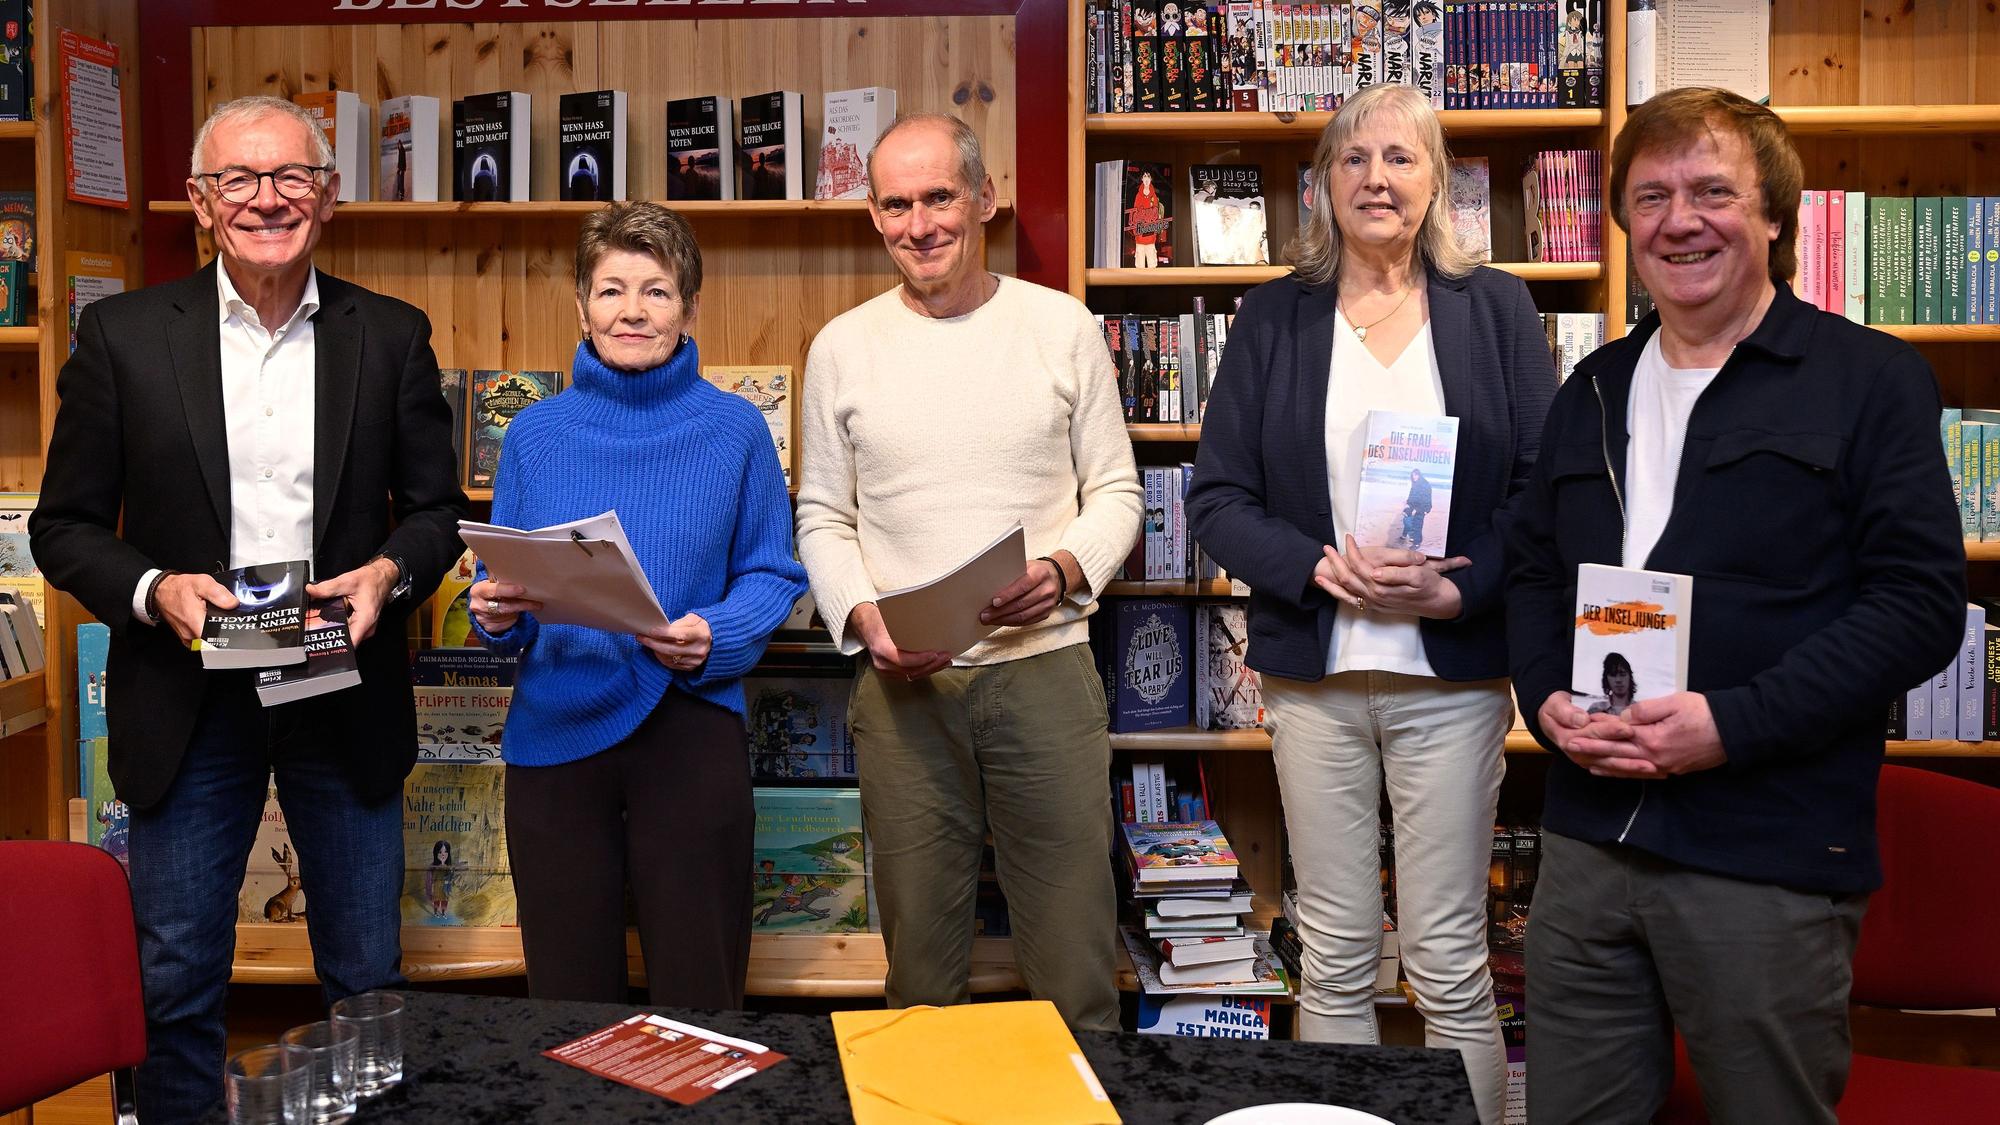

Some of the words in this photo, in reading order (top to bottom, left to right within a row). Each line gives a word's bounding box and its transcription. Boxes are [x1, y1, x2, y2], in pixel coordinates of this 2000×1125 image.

[1417, 52, 1433, 103] NARUT
[1433, 89, 1441, 98] 22
[1568, 89, 1573, 98] 1
[1591, 87, 1598, 97] 2
[466, 123, 486, 133] WENN
[486, 122, 503, 131] HASS
[563, 123, 583, 132] WENN
[585, 121, 604, 130] HASS
[670, 128, 691, 137] WENN
[691, 126, 716, 136] BLICKE
[744, 124, 761, 134] WENN
[762, 121, 782, 131] BLICKE
[466, 134, 485, 144] BLIND
[485, 132, 508, 142] MACHT
[563, 133, 583, 143] BLIND
[584, 131, 611, 141] MACHT
[670, 138, 692, 147] TÖTEN
[744, 134, 763, 145] TÖTEN
[1198, 169, 1260, 182] BUNGO
[1951, 206, 1959, 253] BILLIONAIRES
[1951, 254, 1959, 297] DREAMLAND
[1564, 332, 1574, 353] FRUITS
[1583, 333, 1593, 353] FRUITS
[1390, 431, 1403, 445] DIE
[1407, 432, 1432, 447] FRAU
[1368, 444, 1384, 458] DES
[1388, 447, 1450, 464] INSELJUNGEN
[1966, 491, 1976, 525] HOOVER
[1987, 490, 1996, 524] HOOVER
[208, 614, 259, 623] MACHT
[260, 607, 300, 619] BLIND
[1583, 604, 1601, 621] DER
[1604, 606, 1666, 630] INSELJUNGE
[220, 622, 257, 630] HASS
[260, 616, 300, 629] WENN
[1138, 627, 1170, 650] LOVE
[303, 639, 347, 652] WENN
[1145, 651, 1162, 661] WILL
[1987, 640, 1995, 680] LUCKIEST
[260, 675, 281, 684] Krimi
[443, 672, 498, 687] Mamas
[1126, 663, 1161, 689] TEAR
[1166, 657, 1182, 676] US
[1142, 683, 1166, 694] APART
[410, 783, 420, 793] In
[103, 801, 128, 820] MEE
[439, 799, 467, 812] wohnt
[778, 814, 840, 823] Leuchtturm
[790, 824, 845, 834] Erdbeereis
[1493, 841, 1510, 849] EXIT
[1516, 839, 1534, 848] EXIT
[1205, 1009, 1264, 1028] MANGA
[1176, 1022, 1206, 1037] IST
[1210, 1026, 1264, 1041] NICHT
